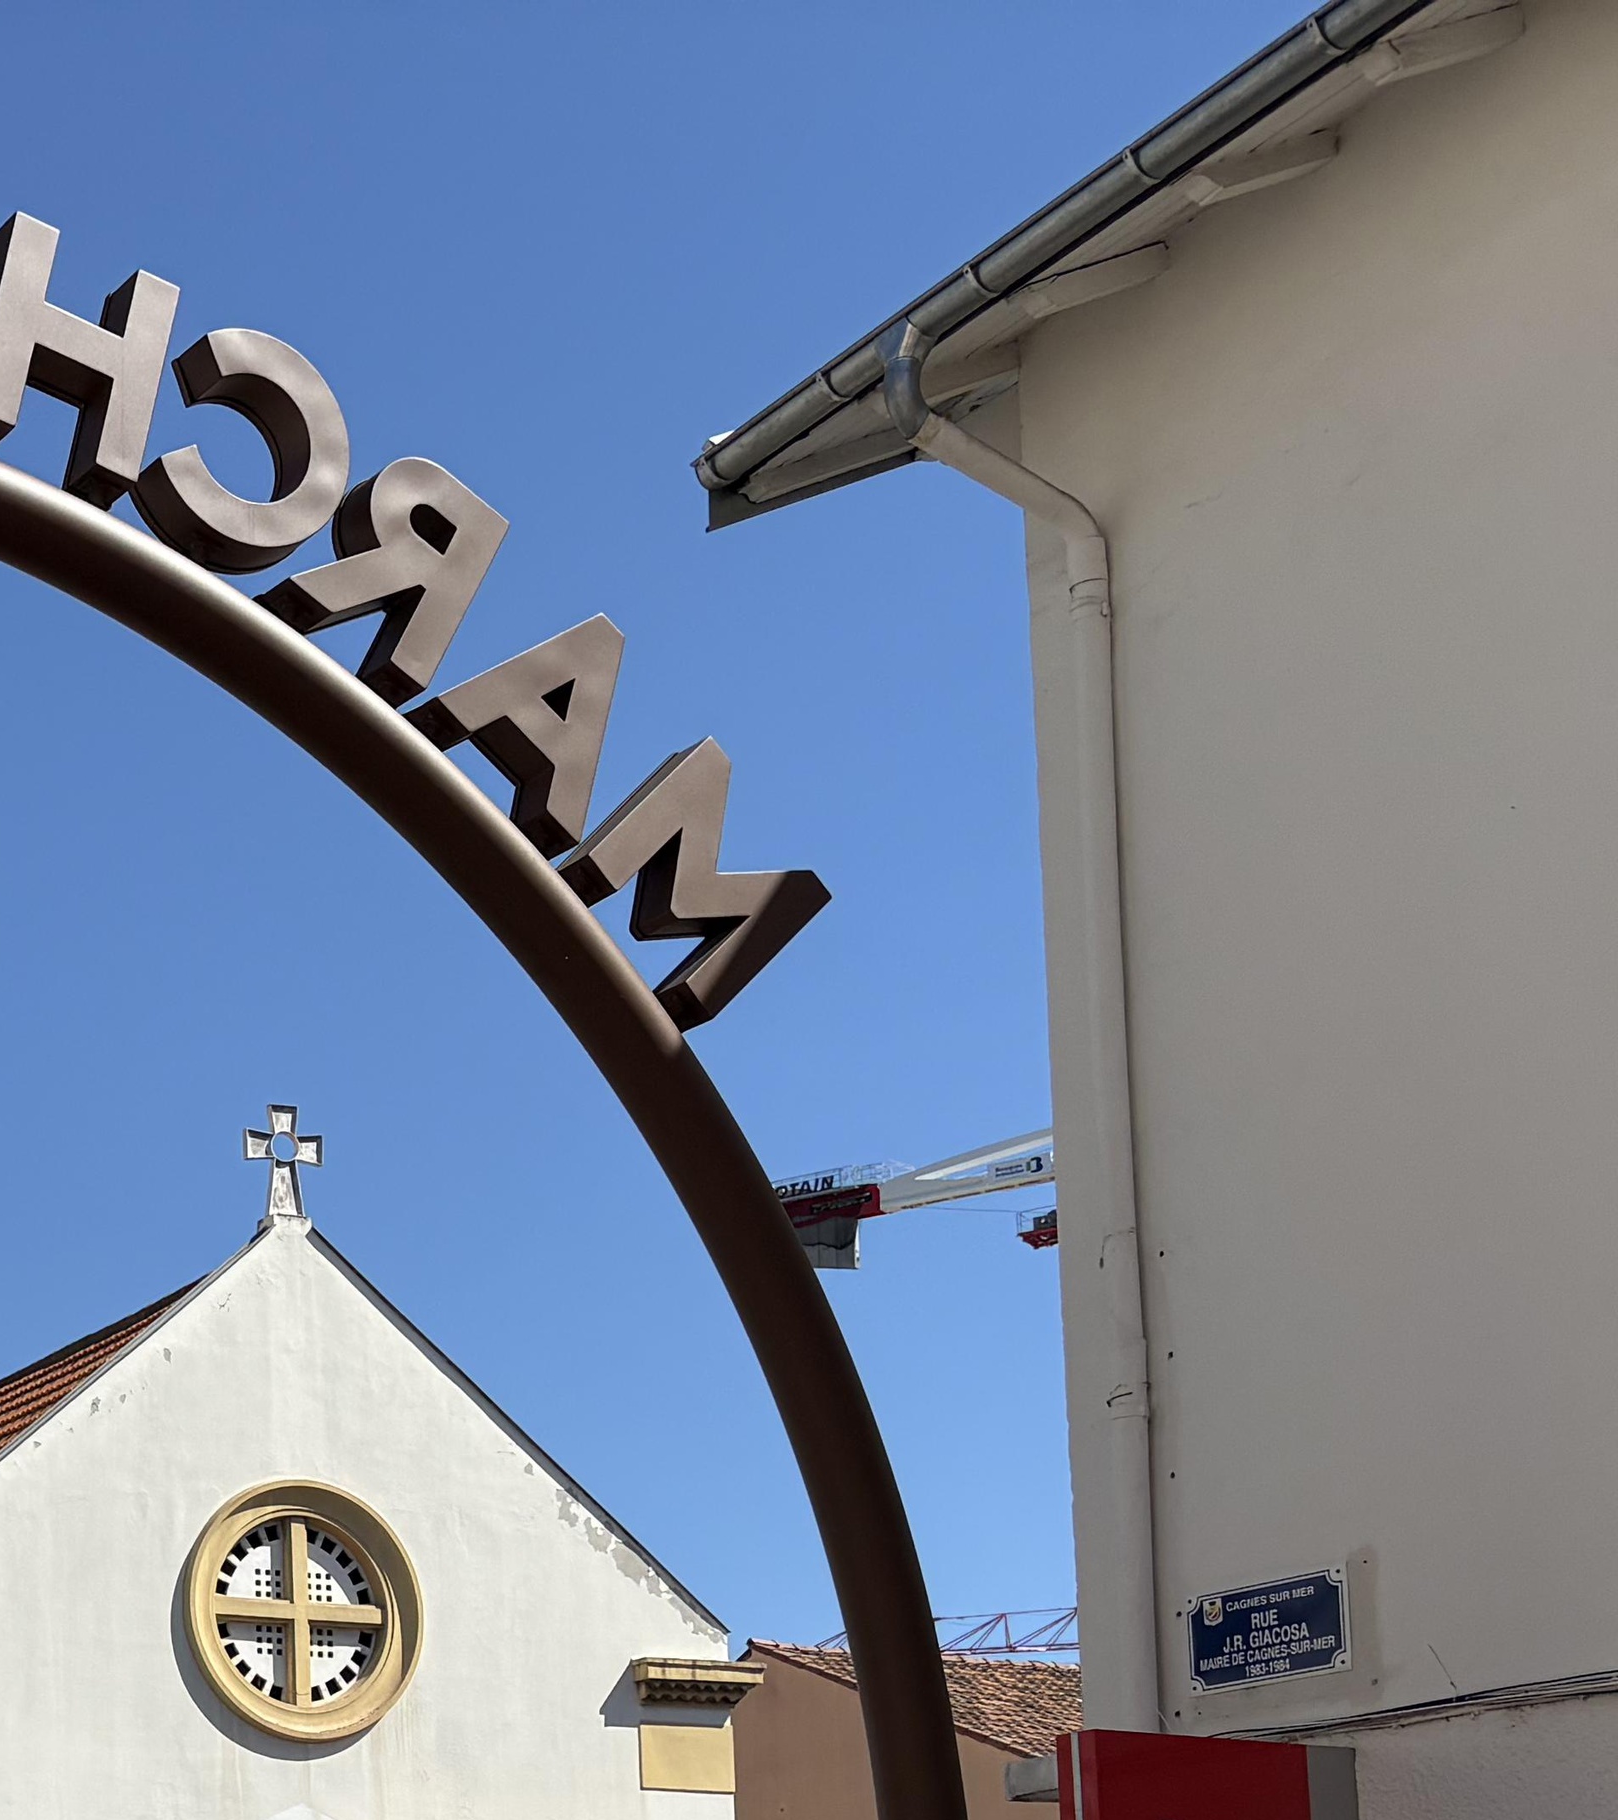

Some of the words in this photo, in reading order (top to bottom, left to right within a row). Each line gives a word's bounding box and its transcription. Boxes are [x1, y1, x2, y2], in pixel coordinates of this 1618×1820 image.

[776, 1175, 834, 1199] OTAIN
[1225, 1595, 1267, 1612] CAGNES
[1268, 1590, 1291, 1604] SUR
[1292, 1586, 1315, 1599] MER
[1251, 1609, 1279, 1629] RUE
[1223, 1635, 1246, 1653] J.R.
[1249, 1622, 1310, 1648] GIACOSA
[1199, 1654, 1230, 1672] MAIRE
[1231, 1652, 1245, 1666] DE
[1247, 1635, 1336, 1663] CAGNES-SUR-MER
